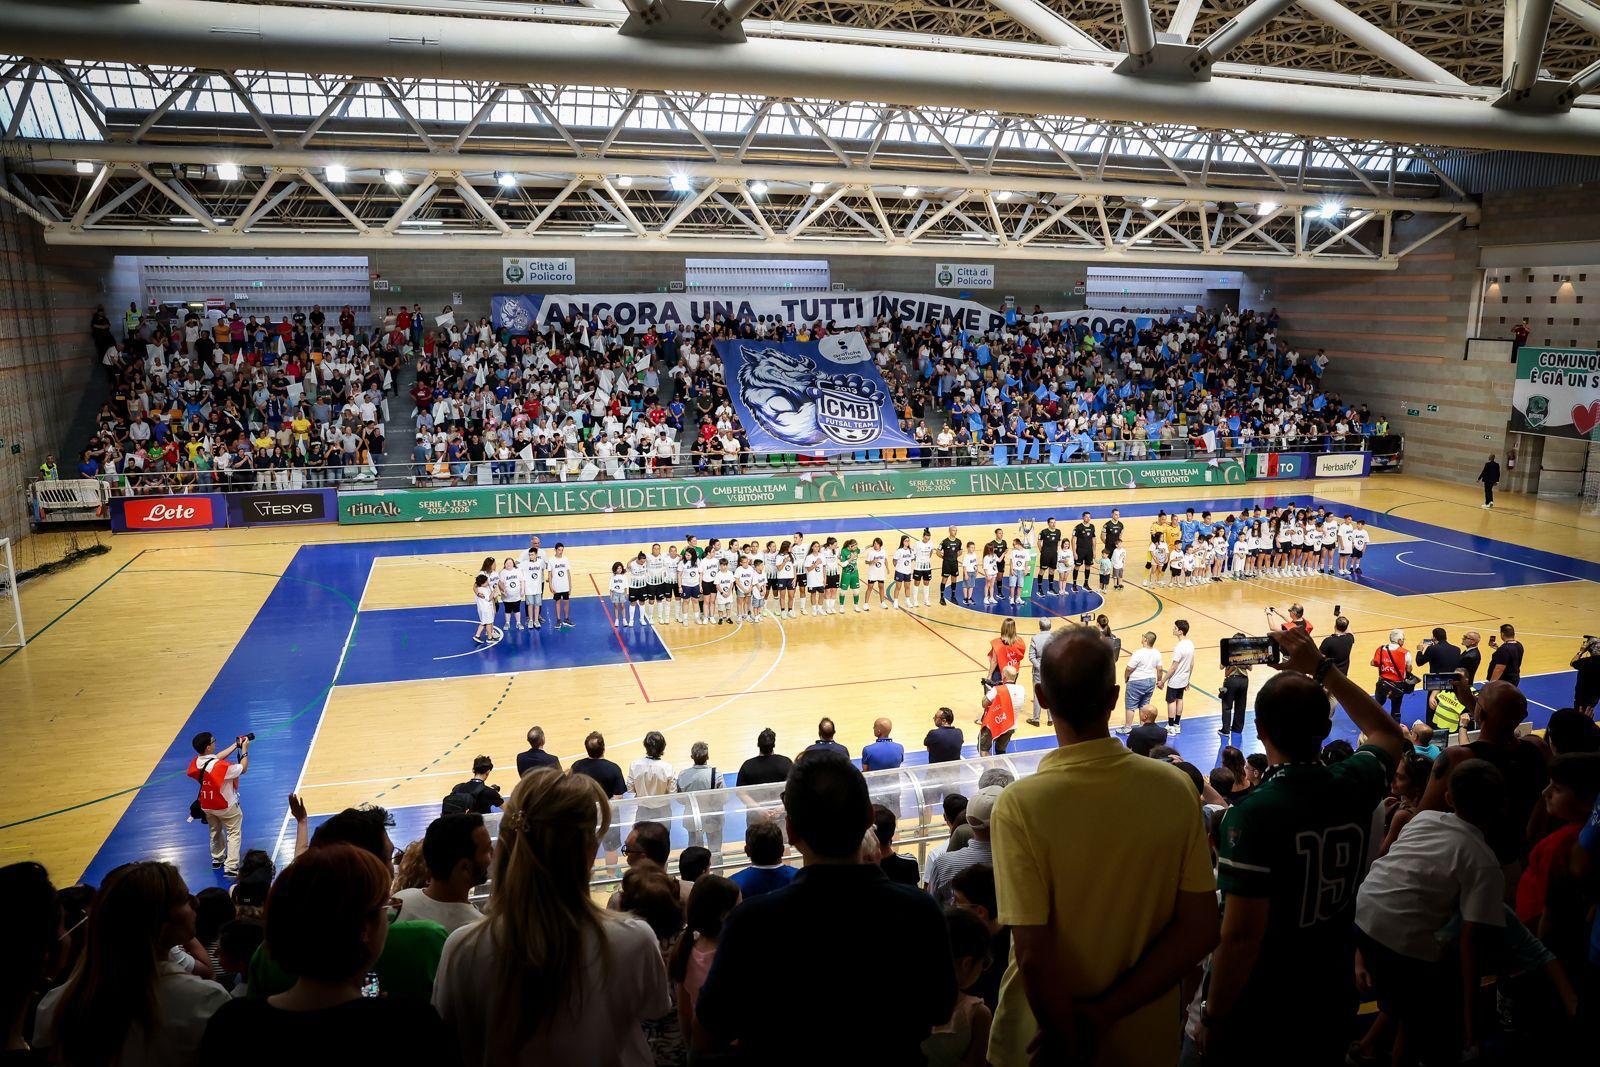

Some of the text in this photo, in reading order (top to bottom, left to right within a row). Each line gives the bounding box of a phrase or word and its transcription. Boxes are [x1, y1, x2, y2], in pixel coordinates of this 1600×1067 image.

[529, 261, 568, 271] Città di
[530, 272, 573, 281] Policoro
[957, 267, 988, 276] Città di
[957, 277, 992, 286] Policoro
[543, 300, 682, 327] ANCORA
[781, 297, 864, 322] TUTTI
[873, 295, 982, 331] INSIEME
[1541, 370, 1564, 386] GIÀ
[1568, 373, 1588, 388] UN
[834, 385, 858, 394] 2013
[825, 418, 874, 429] FUTSAL TEAM
[1322, 461, 1354, 472] Herbalife
[1156, 468, 1180, 477] FUTSAL
[1179, 468, 1199, 476] TEAM
[908, 479, 928, 487] SERIE
[935, 478, 957, 486] TESYS
[969, 467, 1135, 492] FINALE SCUDETTO
[1160, 475, 1190, 484] BITONTO
[712, 483, 787, 495] CMB FUTSAL TEAM
[916, 484, 951, 493] 2025-2026
[495, 485, 704, 515] FINALE SCUDETTO
[727, 492, 774, 502] VS BITONTO
[262, 502, 313, 515] TESYS
[418, 499, 478, 509] SERIE A TESYS
[143, 503, 195, 522] Lete
[427, 505, 470, 515] 2025-2026
[1295, 822, 1365, 929] 19
